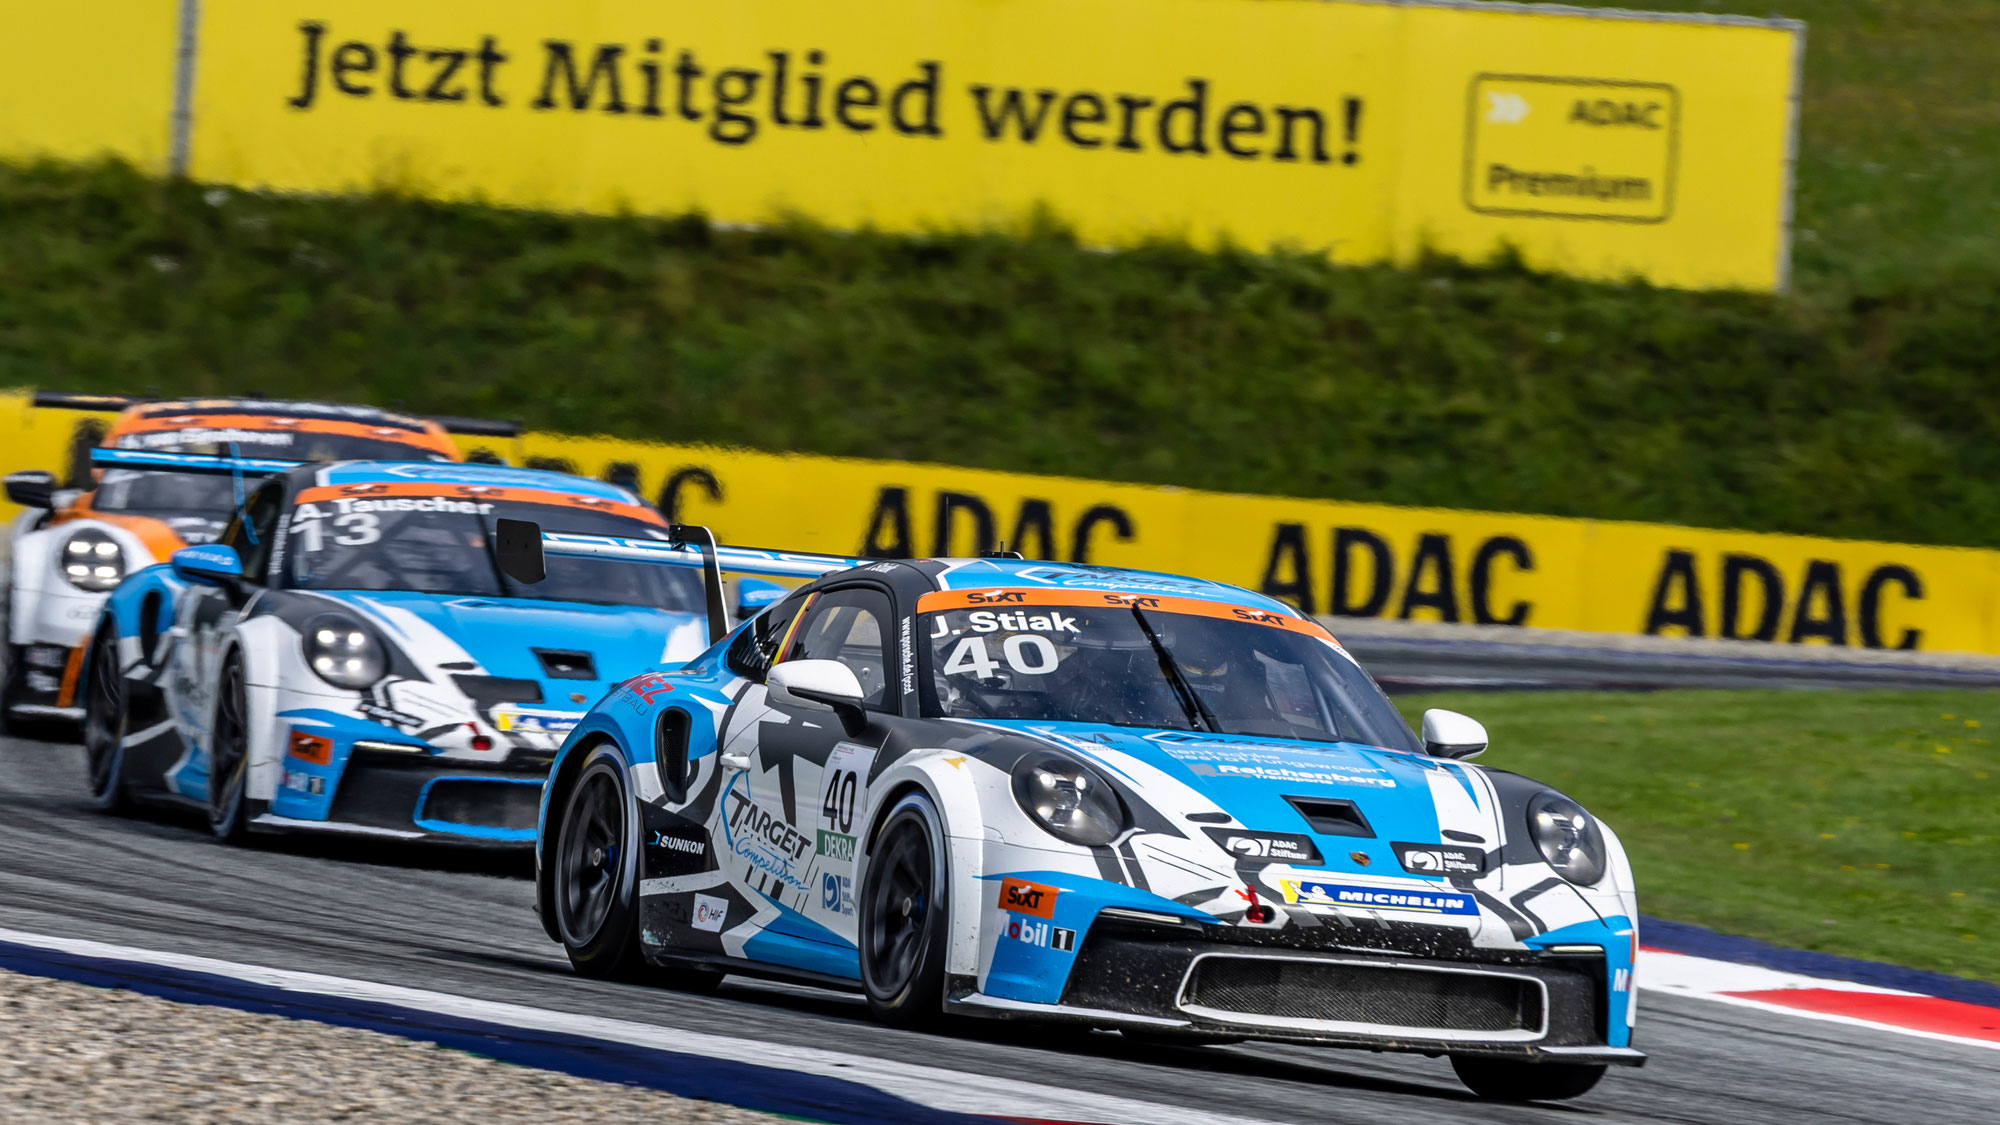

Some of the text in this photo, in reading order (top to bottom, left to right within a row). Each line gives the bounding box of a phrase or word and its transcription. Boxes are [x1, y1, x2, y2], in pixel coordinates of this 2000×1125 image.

[286, 20, 1365, 168] Jetzt Mitglied werden!
[1567, 98, 1665, 132] ADAC
[1486, 162, 1654, 203] Premium
[293, 496, 495, 523] A. Tauscher
[289, 512, 381, 552] 13
[1259, 521, 1537, 627] ADAC
[1643, 547, 1925, 651] ADAC
[930, 611, 1081, 639] J. Stiak
[942, 634, 1060, 680] 40
[823, 768, 857, 834] 40
[660, 835, 705, 855] SUNKON
[729, 789, 812, 861] TARGET
[1272, 840, 1298, 850] ADAC
[735, 837, 810, 891] Competition
[824, 834, 854, 863] DEKRA
[1443, 852, 1466, 861] ADAC
[1339, 890, 1465, 909] MICHELIN
